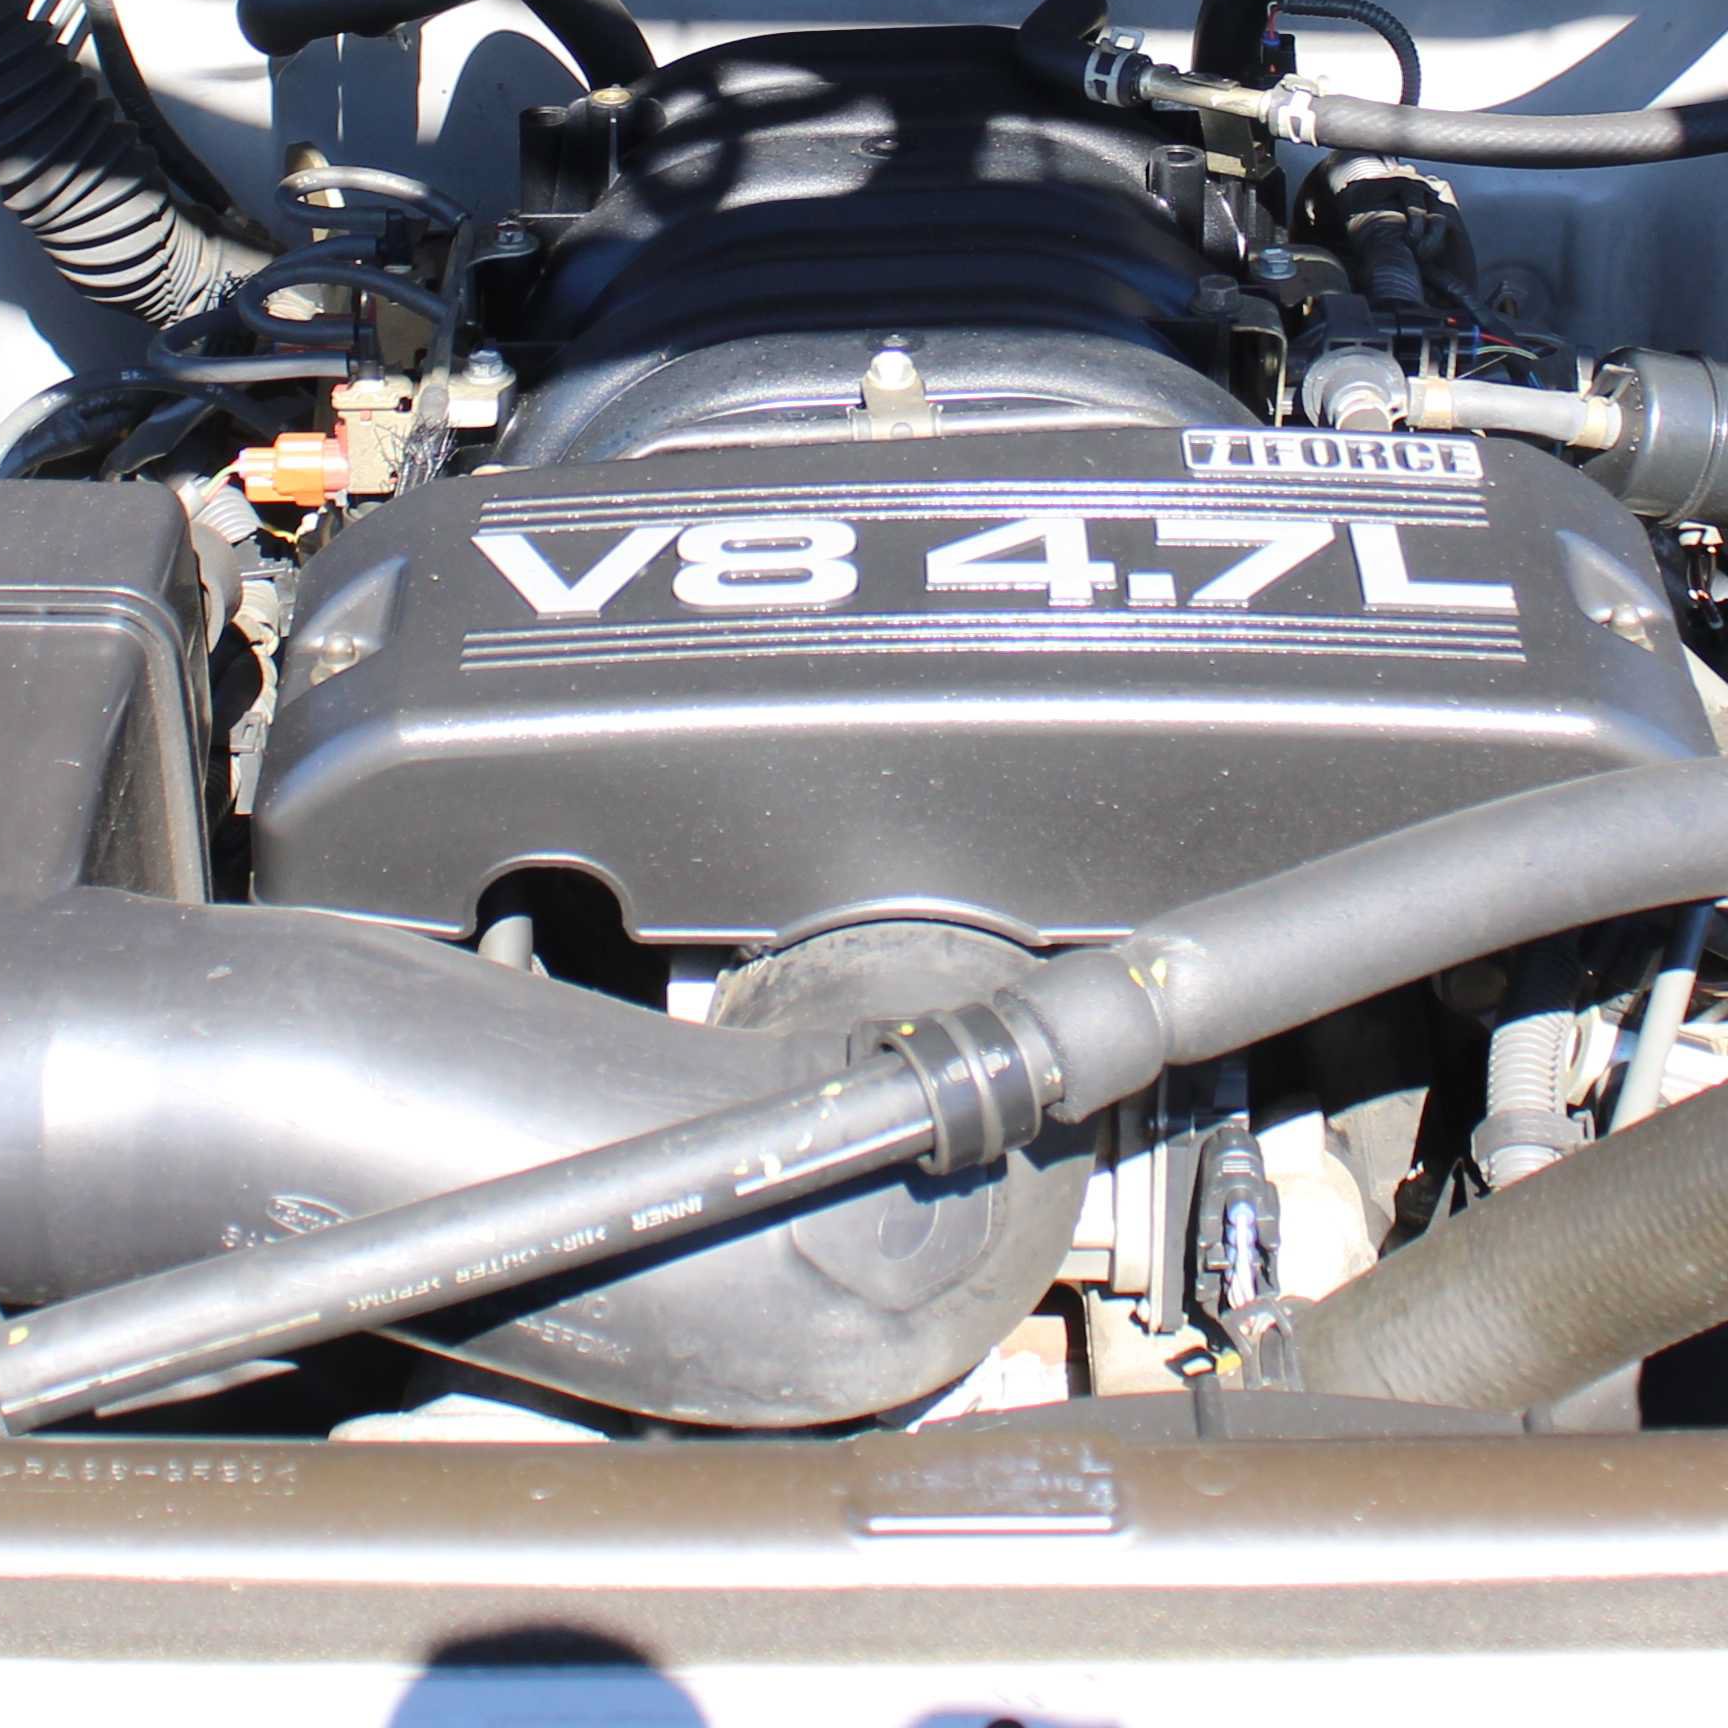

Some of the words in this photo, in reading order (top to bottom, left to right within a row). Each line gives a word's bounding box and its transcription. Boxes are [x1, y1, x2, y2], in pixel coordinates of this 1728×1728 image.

[470, 517, 859, 619] V8
[922, 516, 1520, 616] 4.7L
[631, 1193, 704, 1232] INNER
